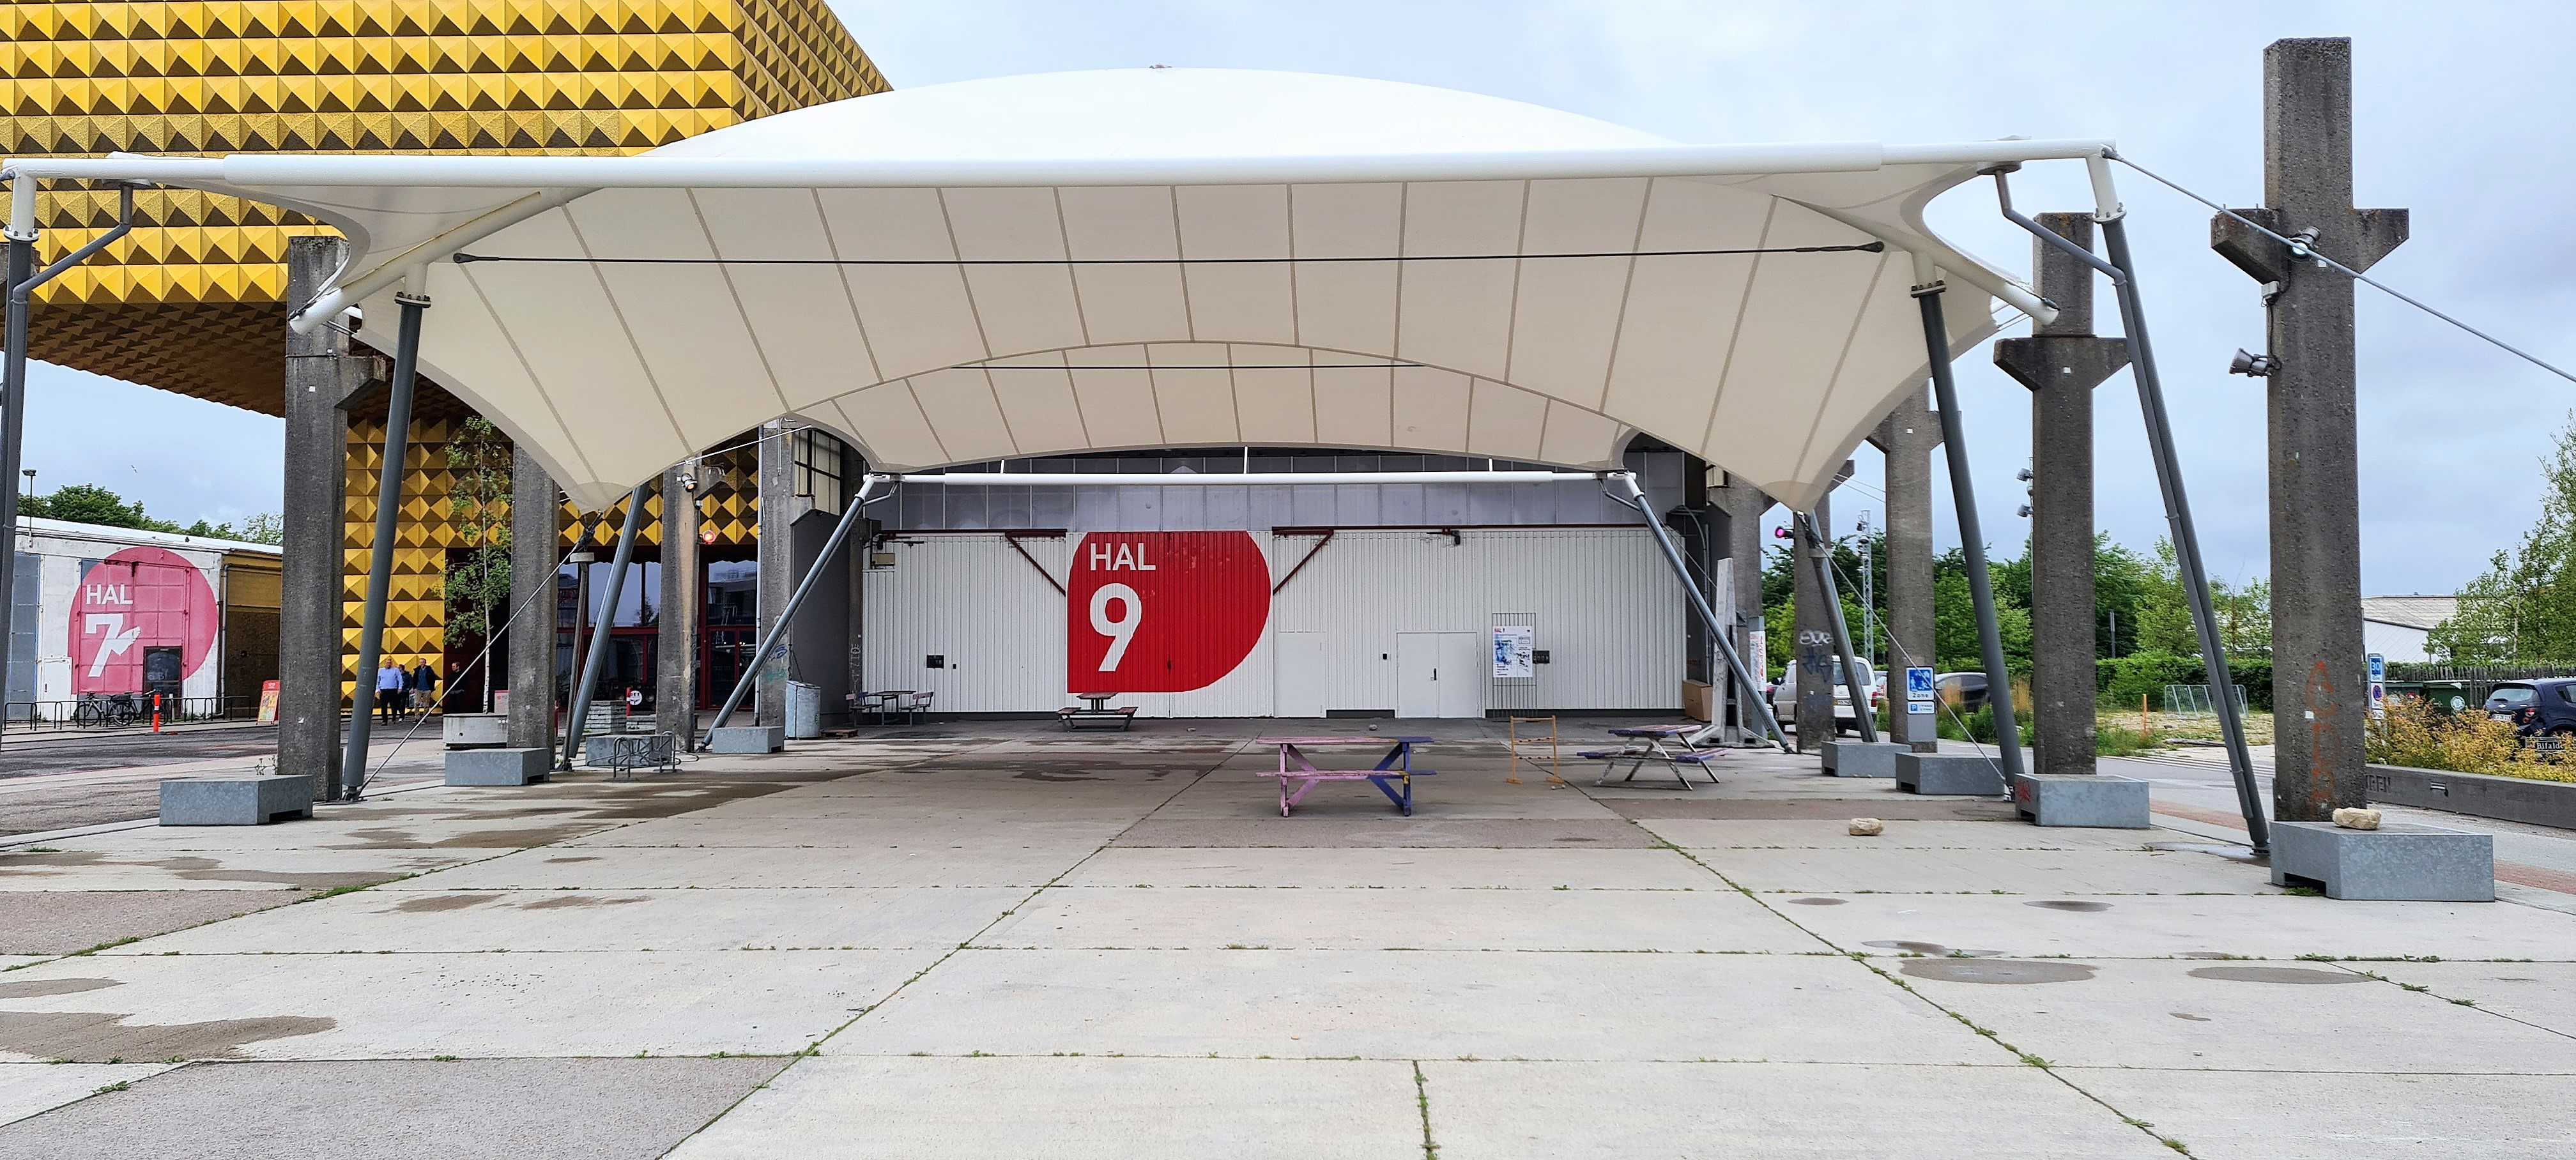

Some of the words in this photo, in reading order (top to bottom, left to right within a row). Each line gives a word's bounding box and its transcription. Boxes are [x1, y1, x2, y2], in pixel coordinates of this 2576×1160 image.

[1090, 542, 1156, 571] HAL
[86, 583, 134, 605] HAL
[1089, 582, 1142, 672] 9
[85, 613, 124, 677] 7
[2371, 662, 2380, 671] 30
